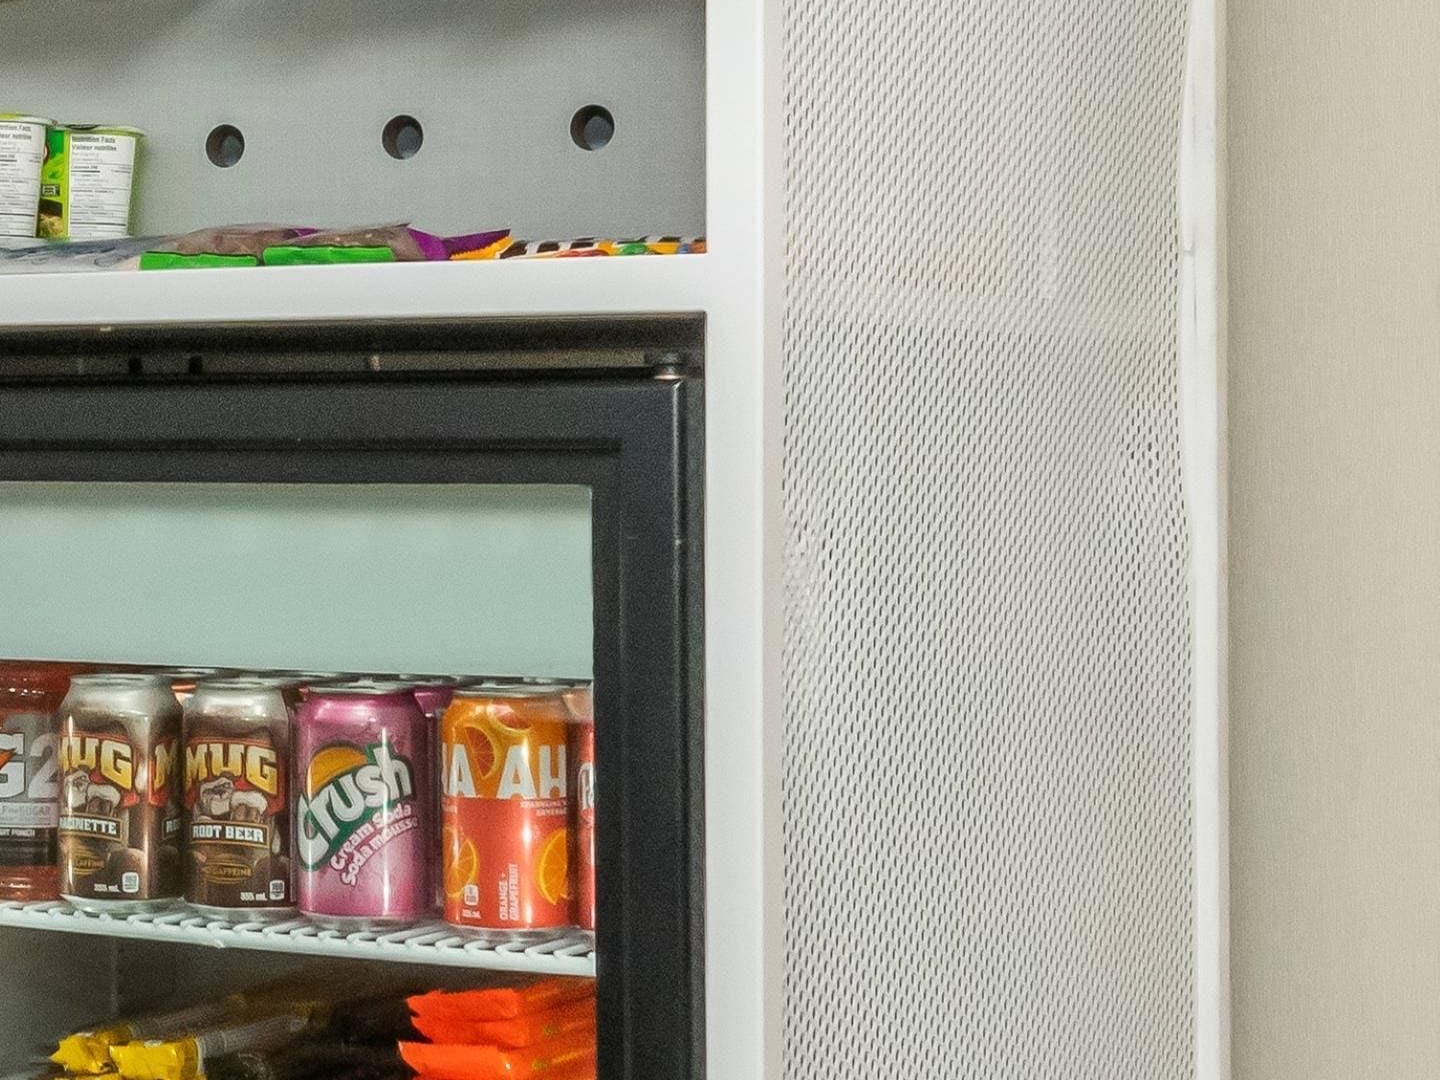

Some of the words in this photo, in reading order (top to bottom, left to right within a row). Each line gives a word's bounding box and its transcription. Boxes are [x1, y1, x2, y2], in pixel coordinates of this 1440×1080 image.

[186, 743, 278, 796] MUG
[192, 824, 223, 839] ROOT
[225, 825, 265, 843] BEER
[298, 740, 413, 867] Crush
[330, 828, 372, 871] Cream
[371, 803, 413, 832] Soda
[344, 841, 377, 886] Soda
[369, 816, 419, 853] mousse
[499, 880, 509, 921] ORANGE
